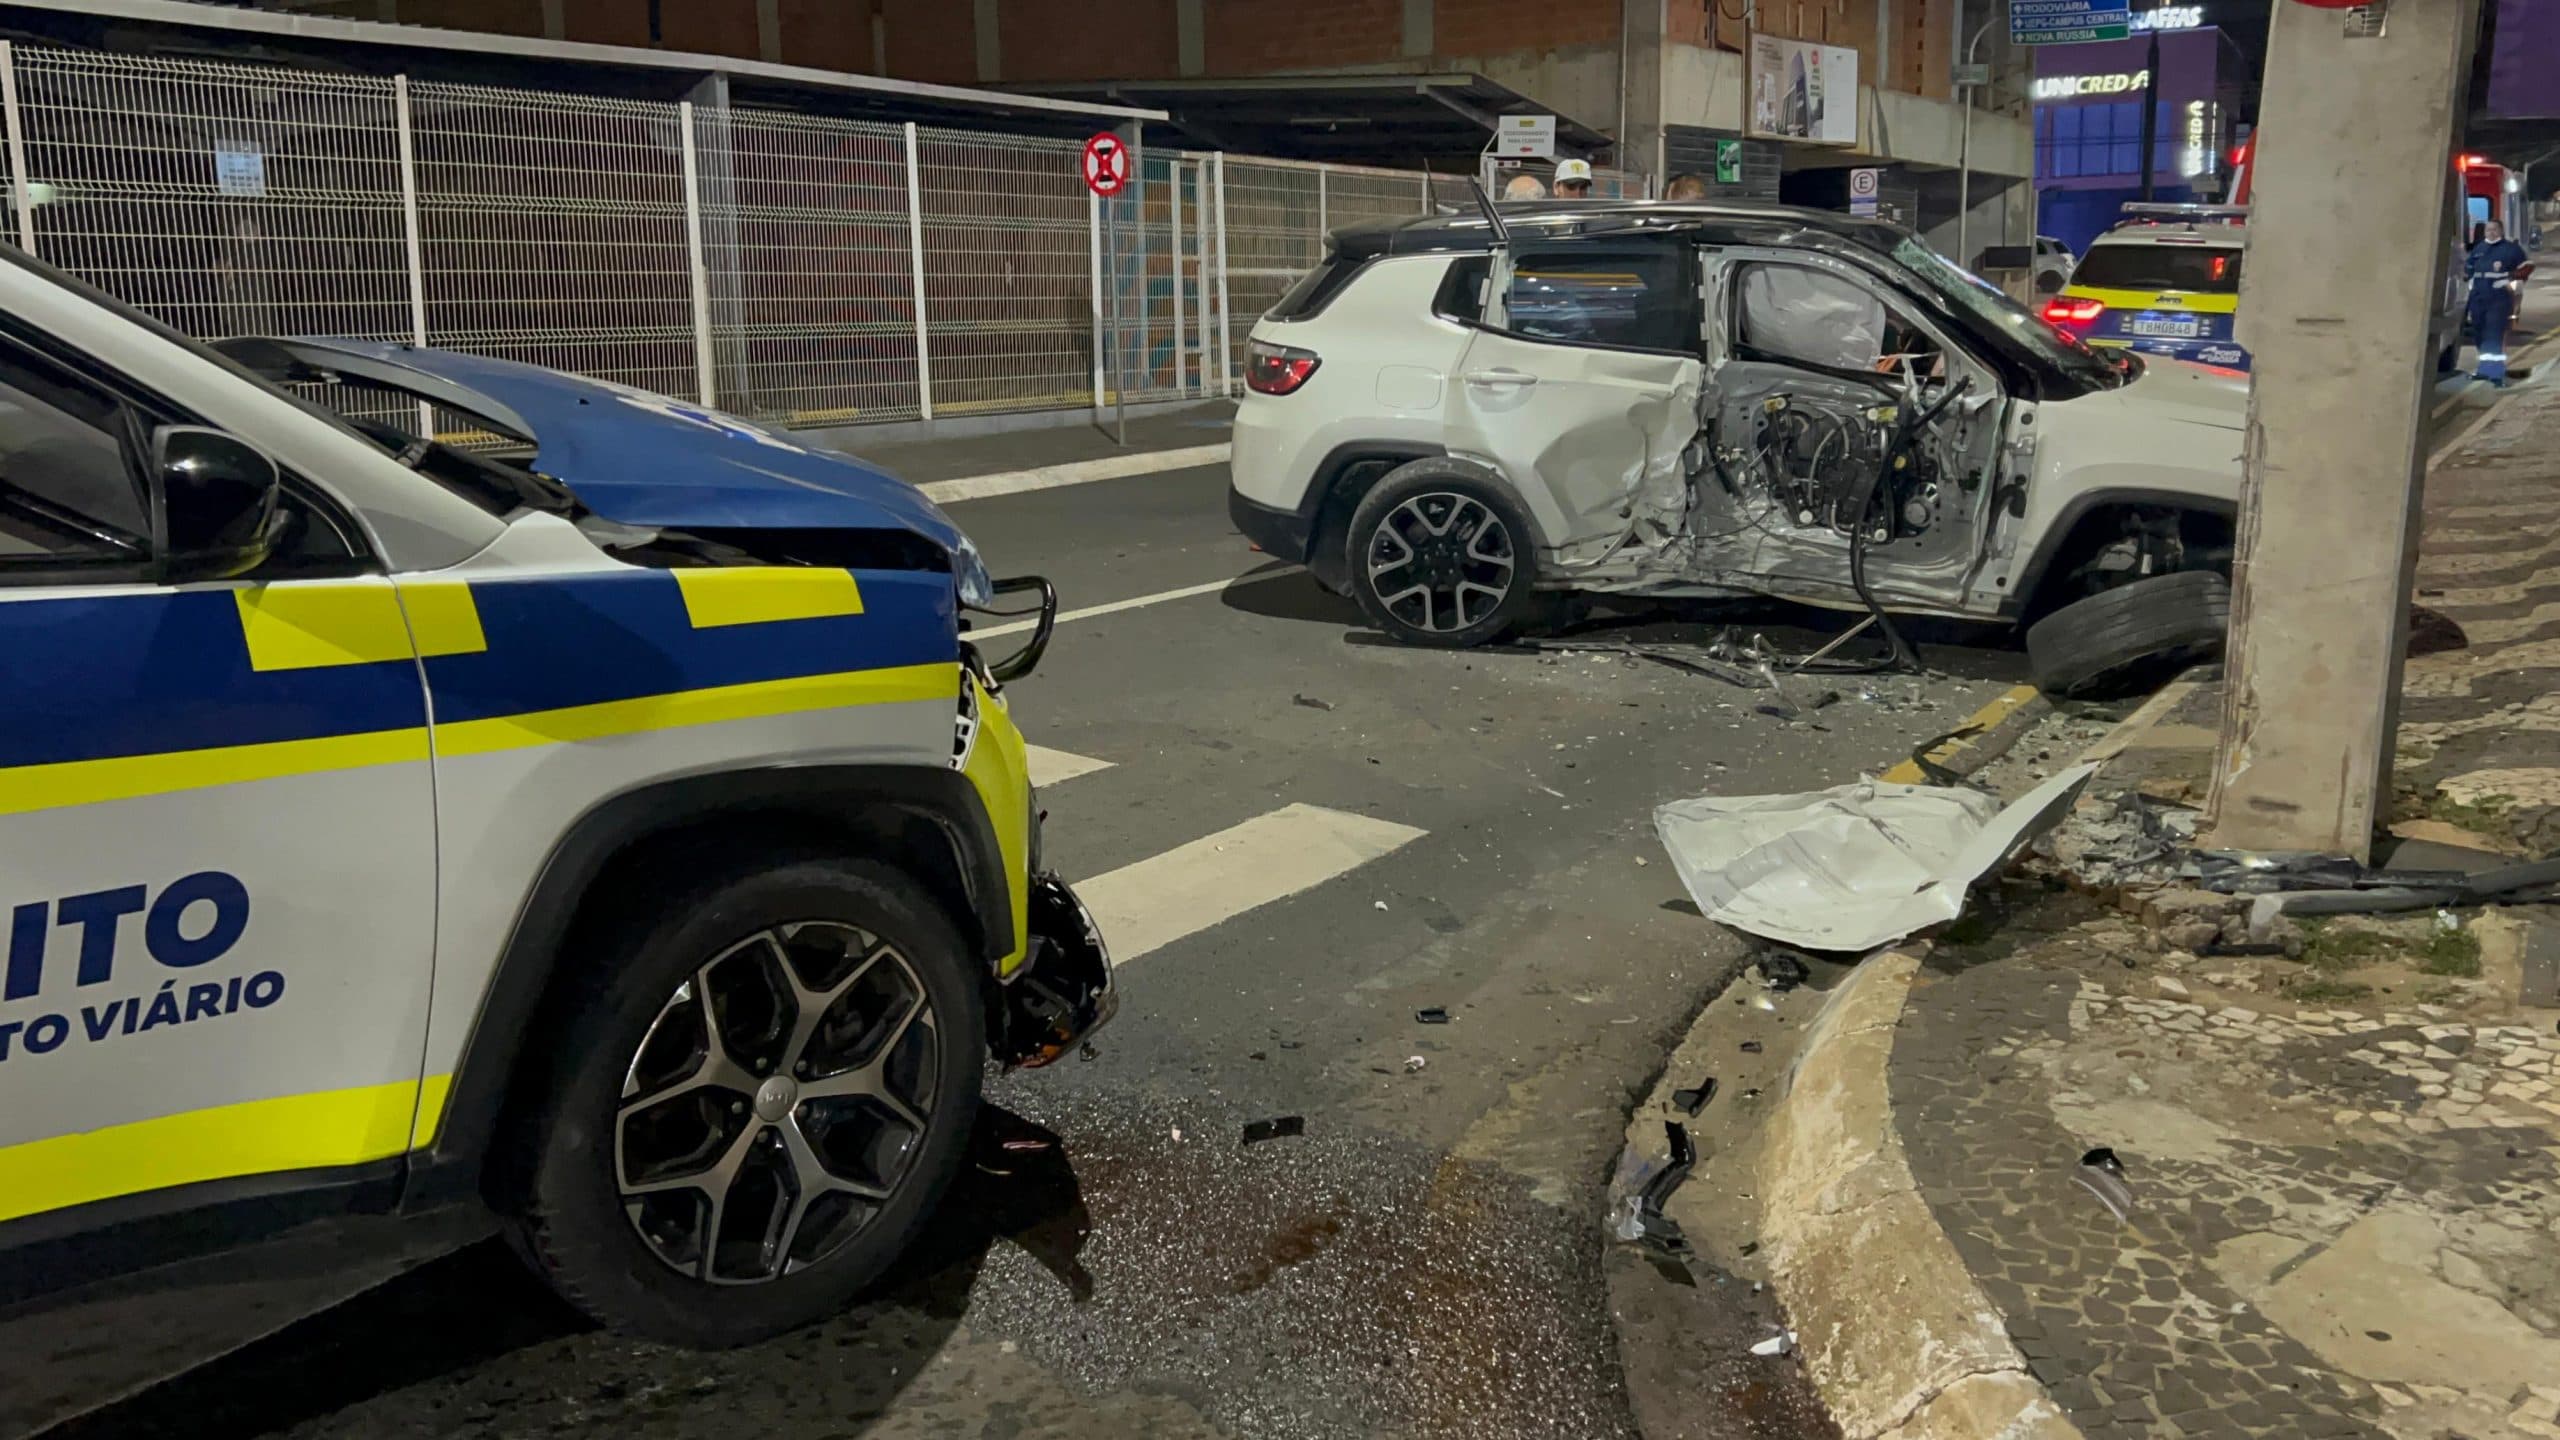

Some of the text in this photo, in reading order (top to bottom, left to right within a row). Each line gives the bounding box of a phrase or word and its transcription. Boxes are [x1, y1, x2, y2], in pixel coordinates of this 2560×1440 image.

[2128, 6, 2202, 29] RAFFAS
[2025, 32, 2054, 41] NOVA
[2036, 73, 2129, 98] UNICRED
[1859, 176, 1868, 189] E
[5, 871, 249, 1000] ITO
[0, 971, 285, 1062] TO VIÁRIO
